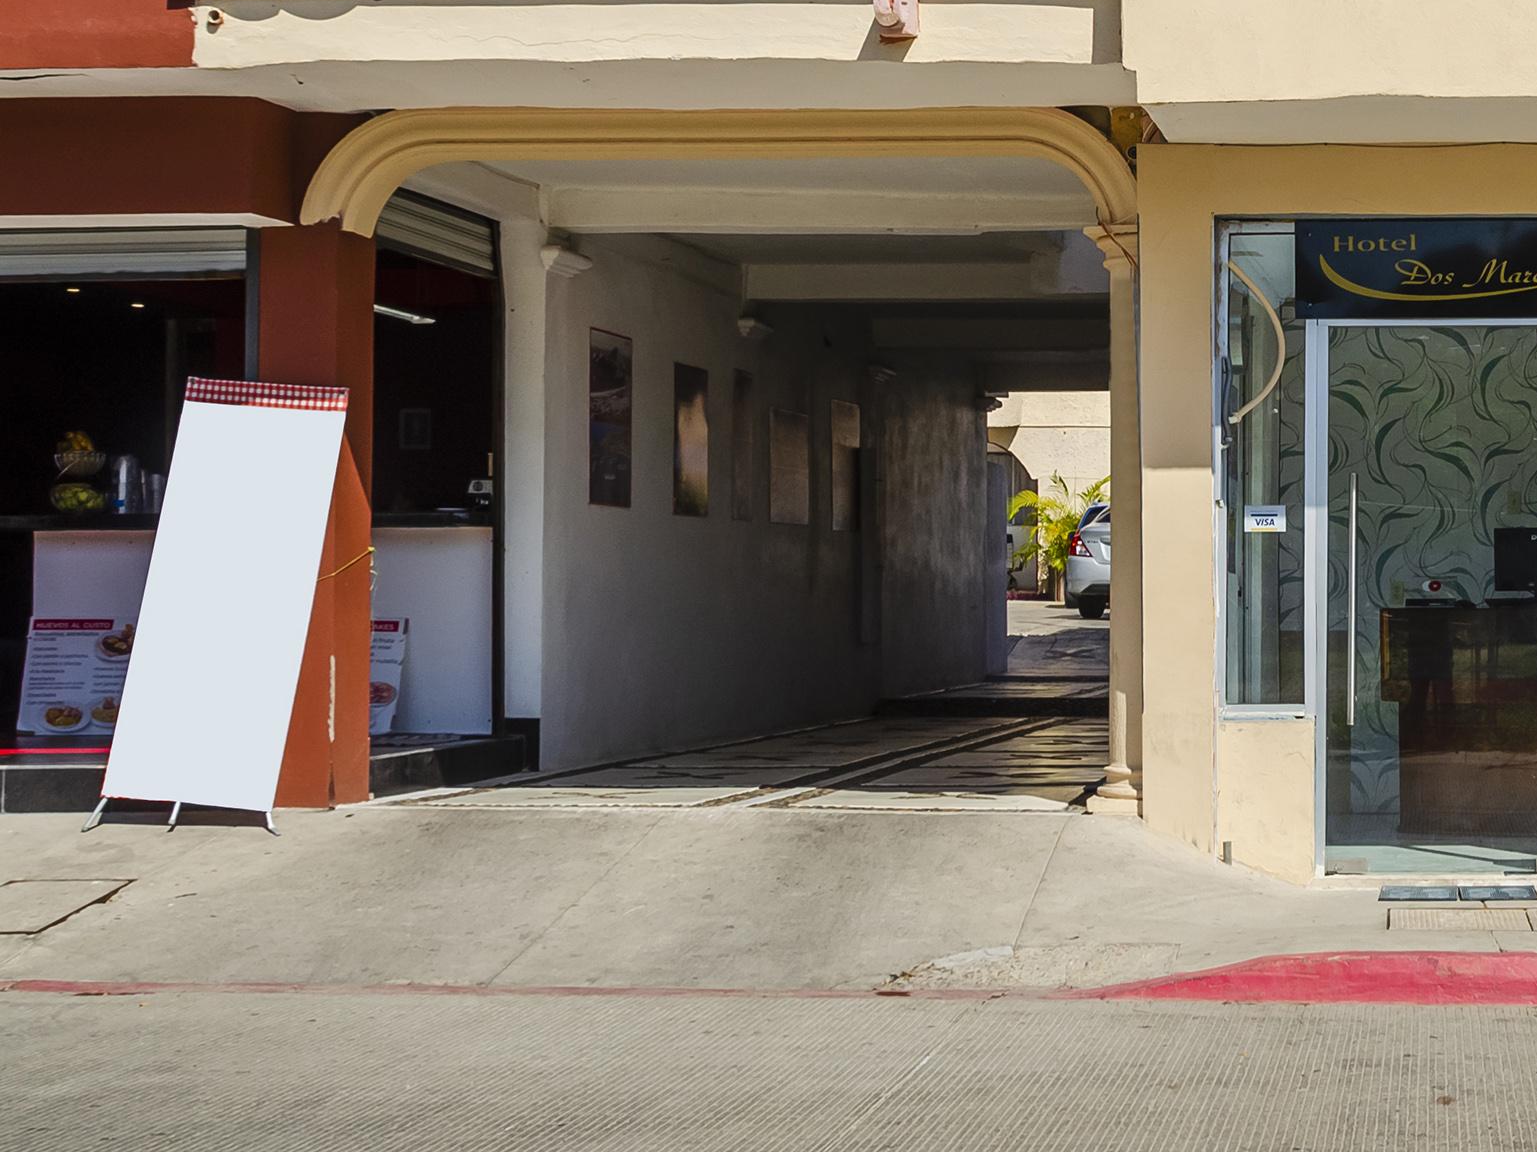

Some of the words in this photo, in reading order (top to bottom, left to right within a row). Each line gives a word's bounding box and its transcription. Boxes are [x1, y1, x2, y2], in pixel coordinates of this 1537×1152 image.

[1333, 234, 1417, 252] Hotel
[1394, 259, 1455, 285] Dos
[1255, 518, 1275, 526] VISA
